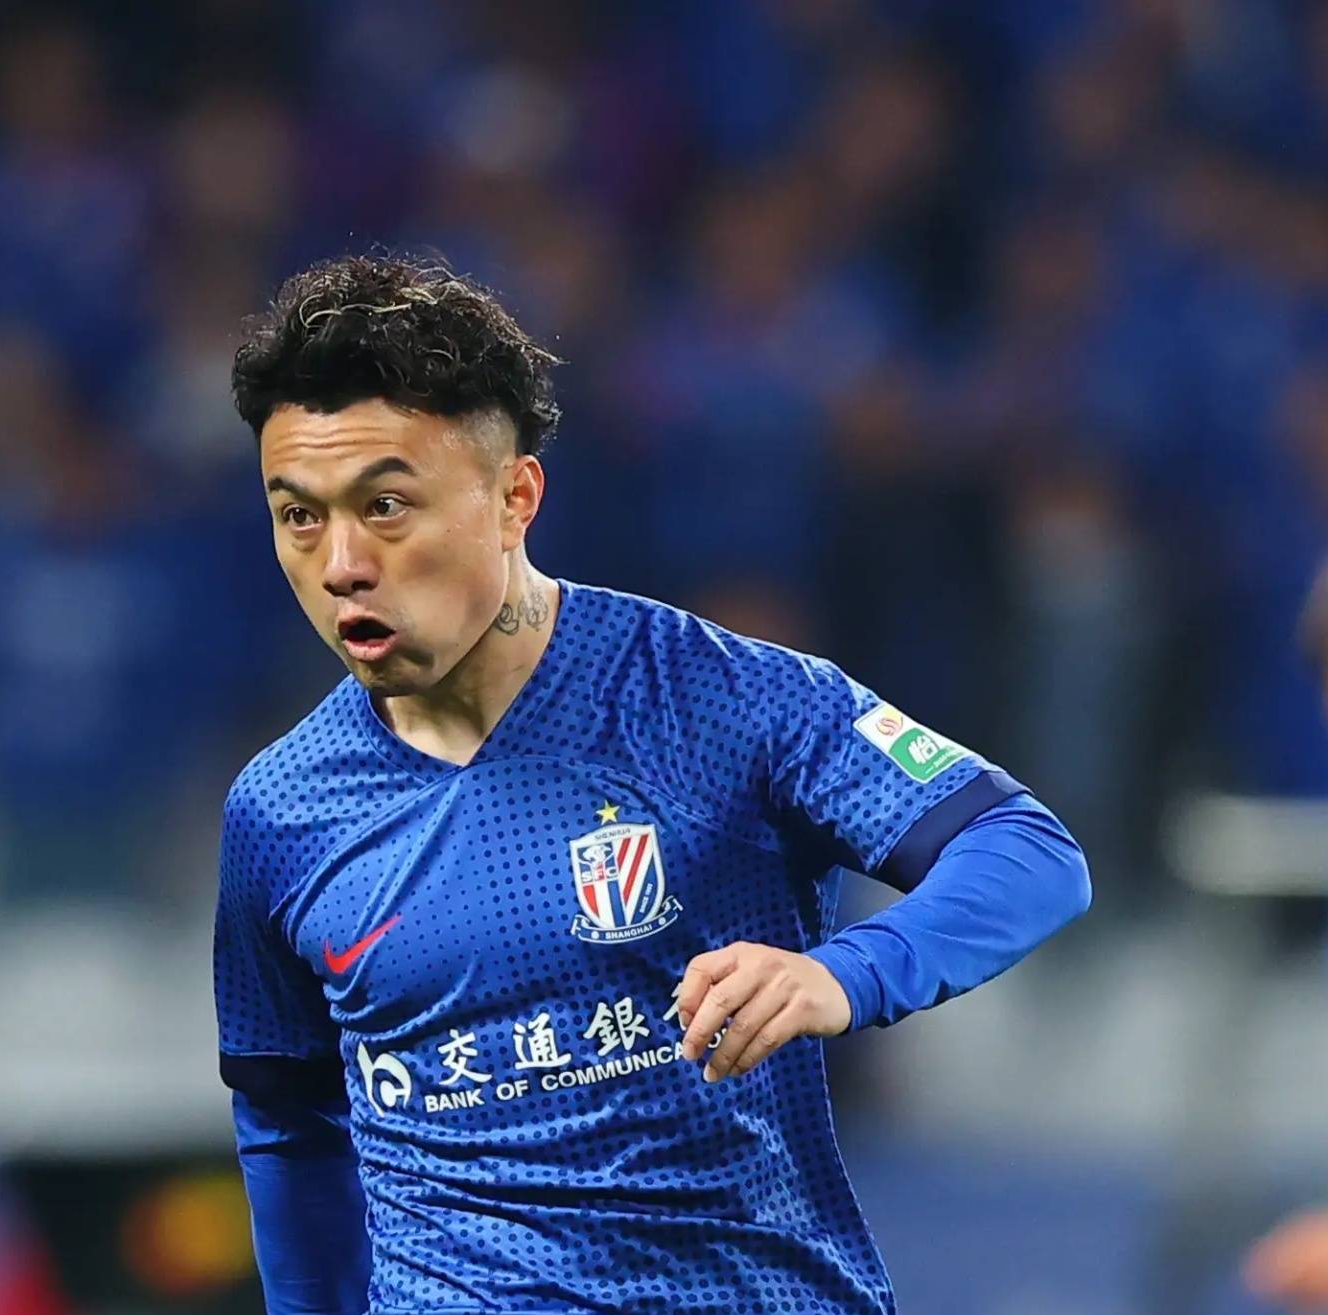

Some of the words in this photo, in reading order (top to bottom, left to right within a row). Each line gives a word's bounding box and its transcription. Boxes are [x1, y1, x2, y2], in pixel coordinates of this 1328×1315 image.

[581, 867, 620, 882] SFC
[606, 925, 653, 940] SHANGHAI
[424, 1088, 485, 1113] BANK
[496, 1080, 528, 1100] OF
[541, 1028, 727, 1091] COMMUNICA
